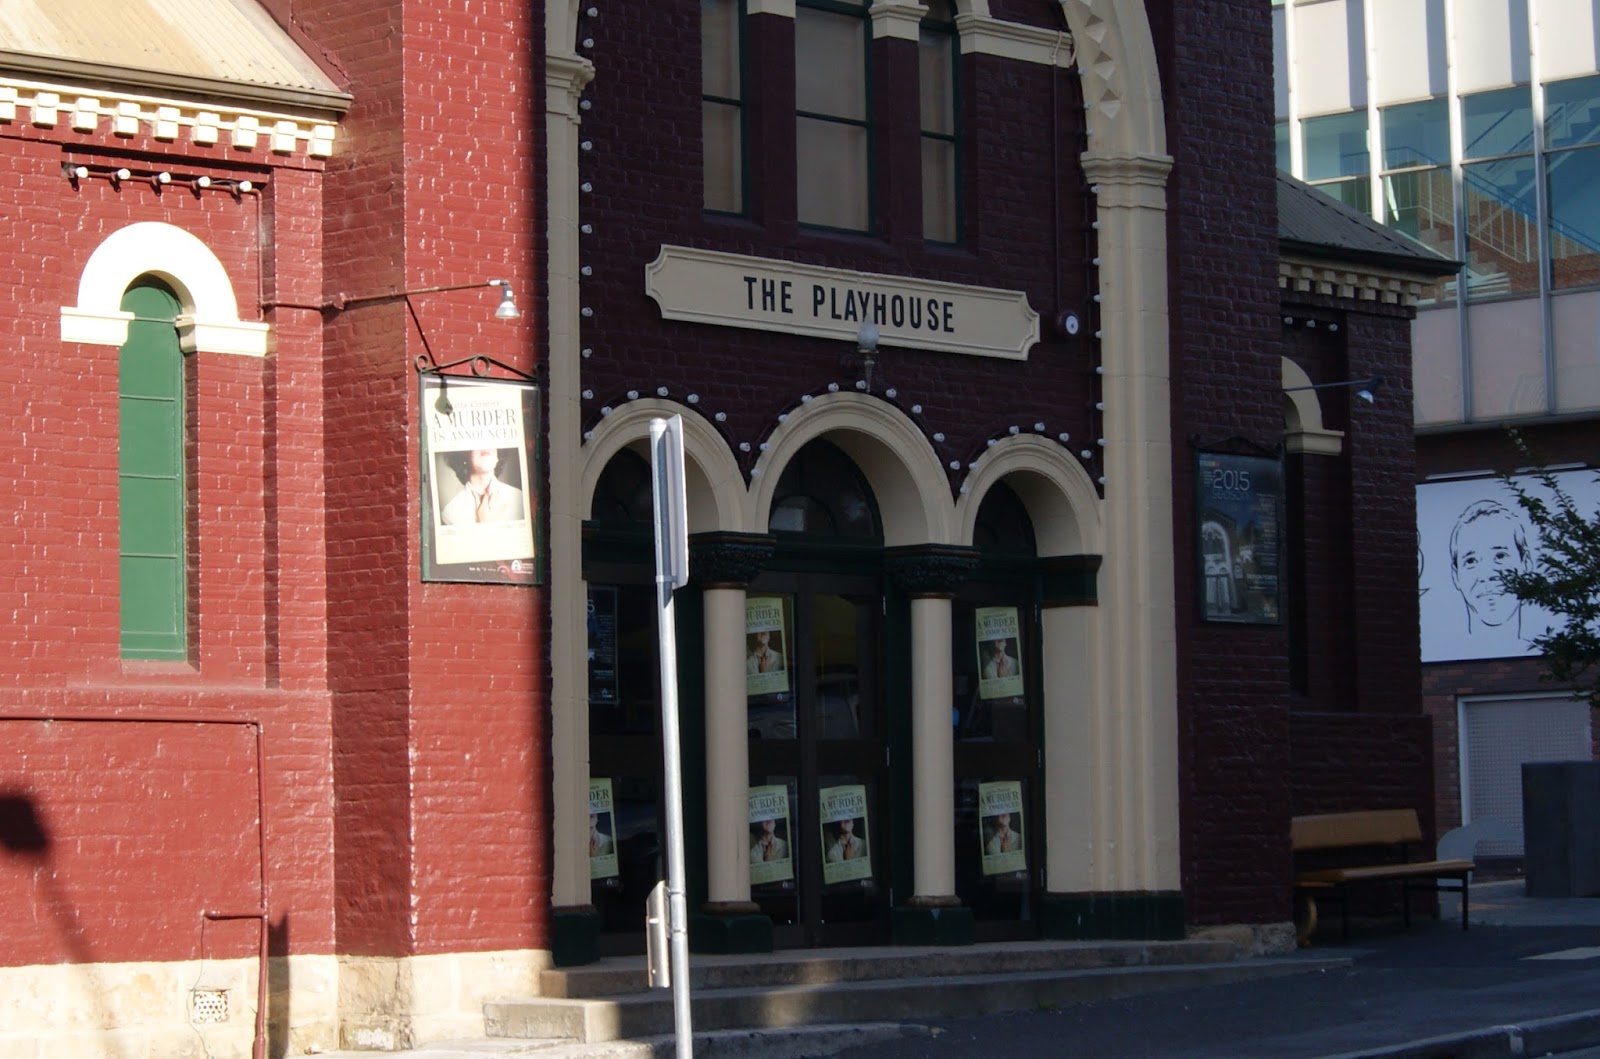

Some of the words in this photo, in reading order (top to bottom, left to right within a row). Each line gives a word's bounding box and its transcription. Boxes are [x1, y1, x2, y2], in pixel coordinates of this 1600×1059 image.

[743, 276, 793, 314] THE
[813, 284, 954, 333] PLAYHOUSE
[445, 408, 516, 428] MURDER
[433, 431, 446, 443] IS
[450, 428, 518, 442] ANNOUNCED
[1212, 469, 1250, 492] 2015
[827, 795, 863, 809] MURDER
